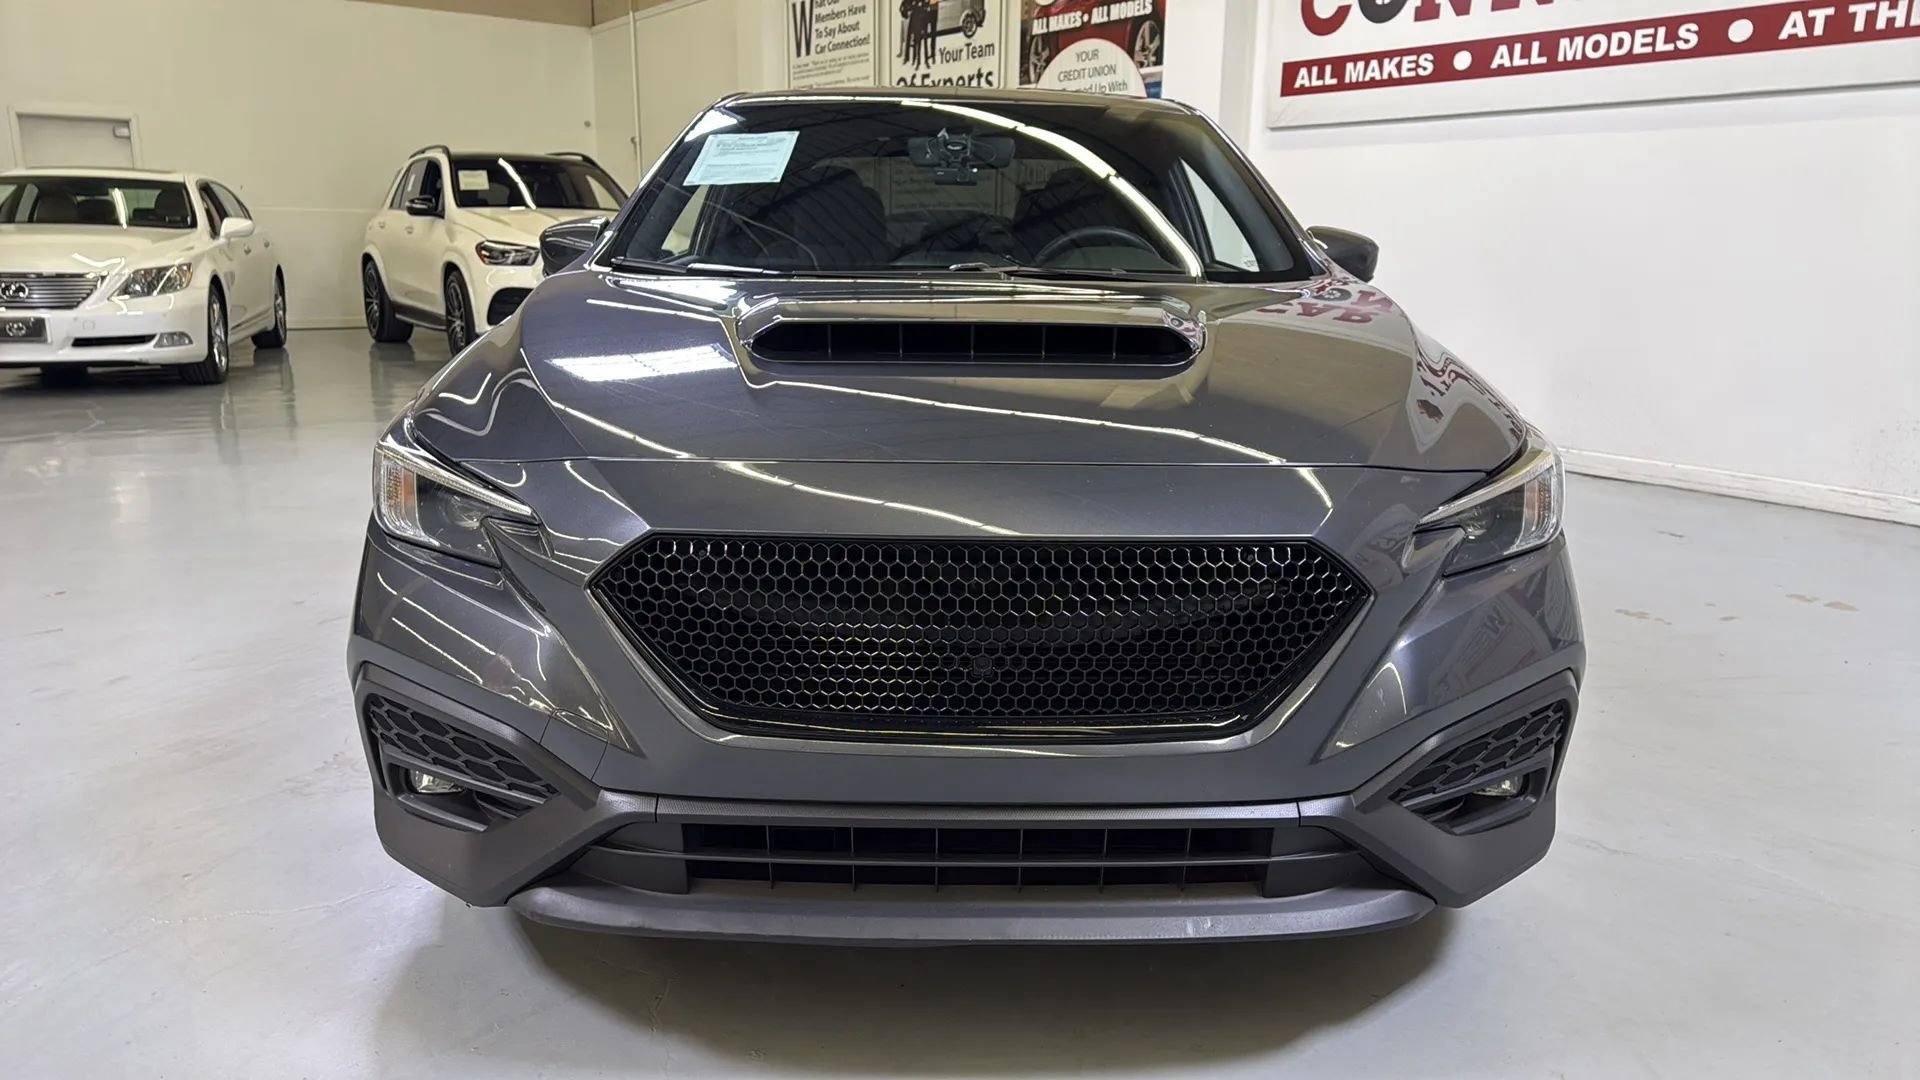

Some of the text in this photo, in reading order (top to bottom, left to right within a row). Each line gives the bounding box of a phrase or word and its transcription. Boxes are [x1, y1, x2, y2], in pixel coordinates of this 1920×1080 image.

[815, 4, 866, 24] Members Have
[1032, 0, 1153, 35] ALL MAKES ALL MODELS
[815, 20, 860, 39] To Say About
[815, 33, 871, 54] Car Connection!
[939, 42, 995, 64] Your Team
[1294, 67, 1338, 88] ALL
[1344, 53, 1434, 83] MAKES
[1490, 41, 1547, 69] ALL
[1557, 23, 1699, 62] MODELS
[1778, 7, 1835, 40] AT
[1075, 48, 1100, 62] YOUR
[1057, 64, 1117, 83] CREDIT UNION
[1108, 80, 1128, 92] With
